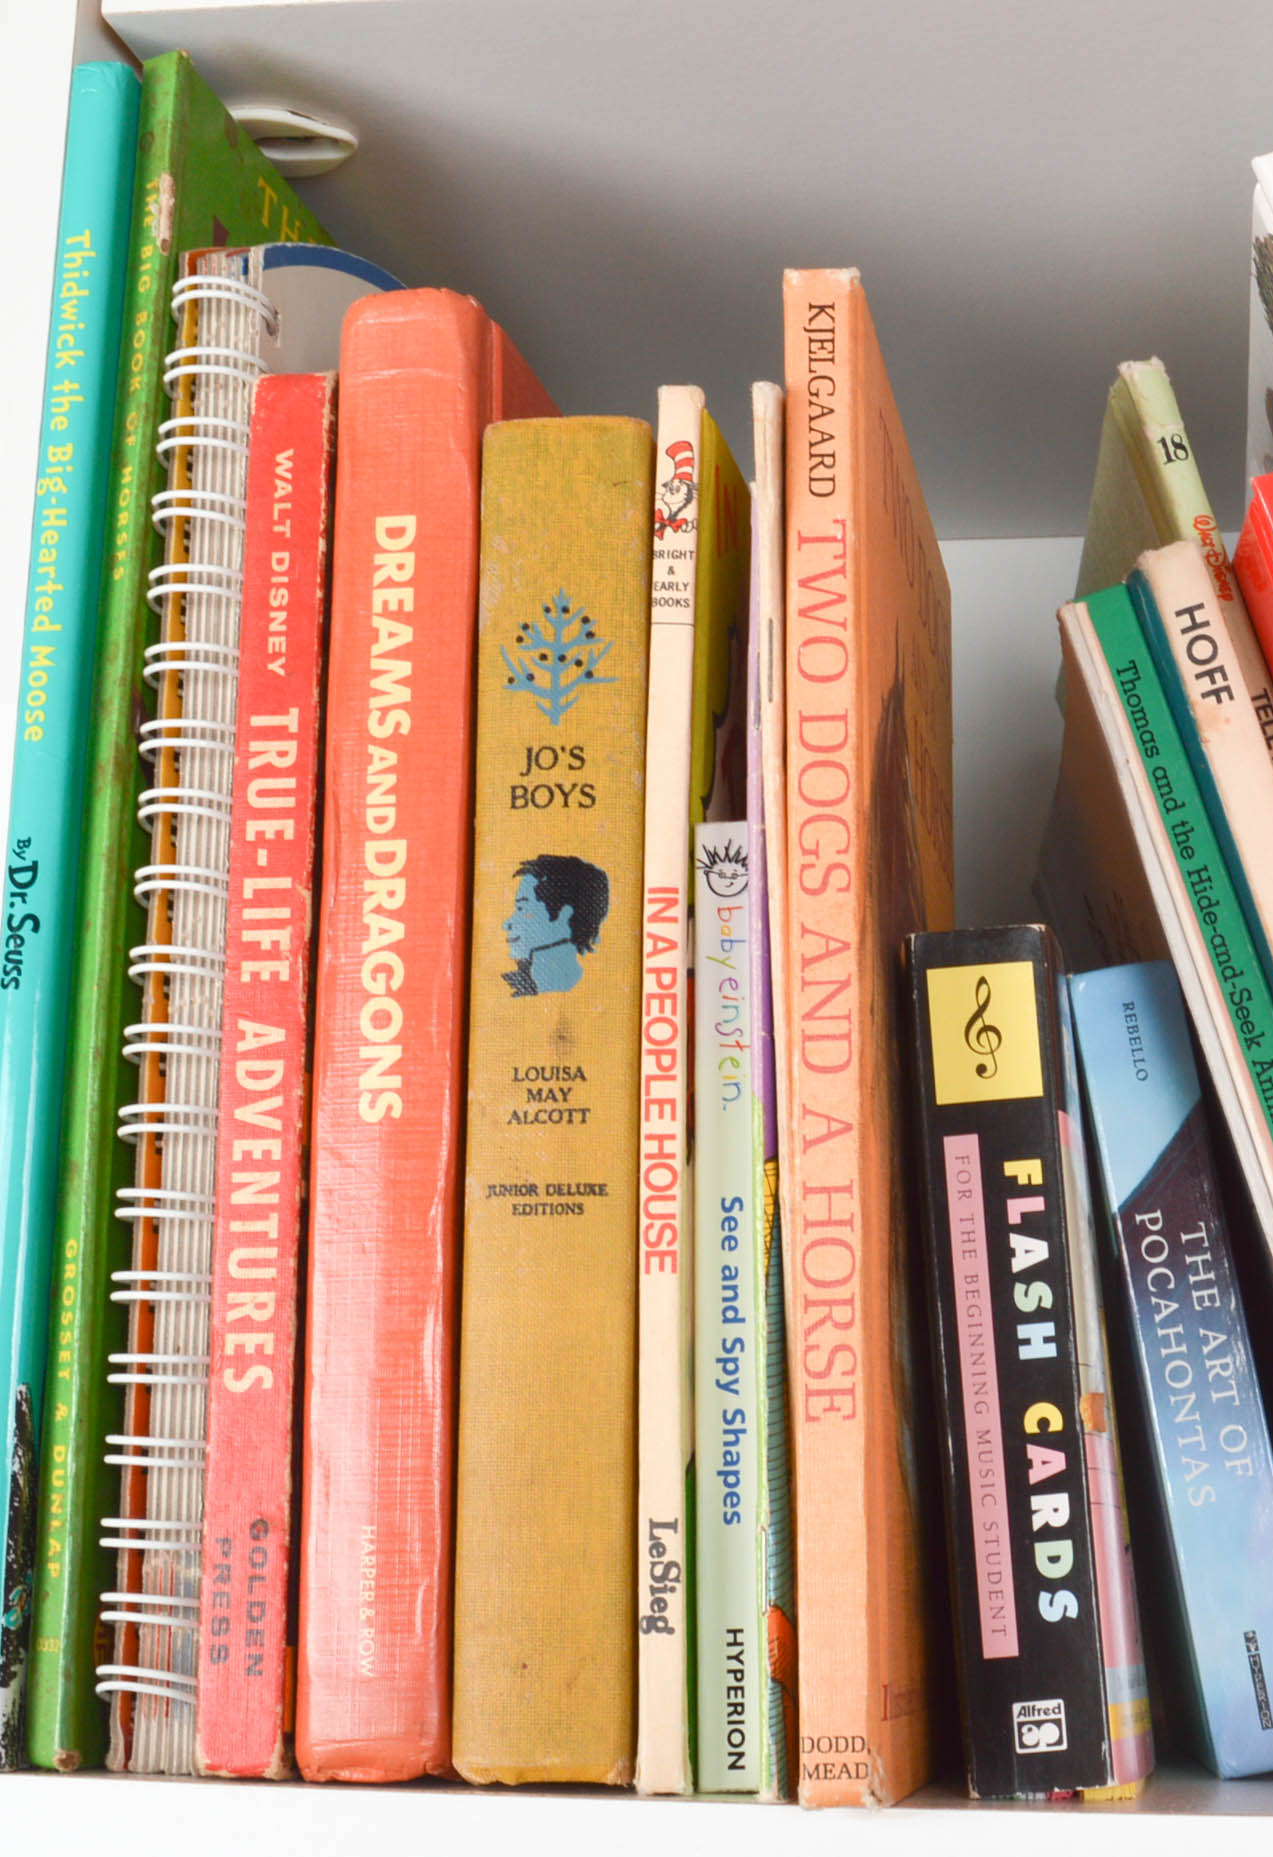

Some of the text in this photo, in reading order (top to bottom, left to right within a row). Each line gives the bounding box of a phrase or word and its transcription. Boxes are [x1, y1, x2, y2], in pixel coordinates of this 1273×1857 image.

[258, 176, 314, 244] TH
[137, 245, 154, 293] BIG
[128, 312, 150, 393] BOOK
[125, 411, 138, 446] OF
[1157, 433, 1189, 465] 18
[24, 229, 96, 742] Thidwick the Big-Hearted Moose
[113, 465, 134, 581] HORSES
[651, 597, 690, 608] BOOKS
[654, 581, 689, 592] EARLY
[667, 565, 675, 576] &
[1175, 602, 1235, 705] HOFF
[510, 783, 597, 810] BOYS
[519, 745, 586, 777] JO'S
[358, 514, 417, 1124] DREAMS AND DRAGONS
[797, 301, 858, 1424] KJELGAARD TWO DOGS AND A HORSE
[1116, 659, 1161, 760] Thomas
[1152, 765, 1187, 815] and
[1171, 819, 1195, 861] the
[1187, 864, 1266, 1051] Hide-and-Seek
[1, 836, 41, 990] By Dr. Seuss
[223, 448, 299, 1393] WALT DISNEY TRUE-LIFE ADVENTURES
[705, 905, 746, 970] baby
[513, 1065, 587, 1084] LOUISA
[643, 887, 680, 1275] IN A PEOPLE HOUSE
[1122, 1000, 1149, 1083] REBELLO
[507, 1108, 592, 1126] ALCOTT
[526, 1086, 573, 1104] MAY
[485, 1182, 609, 1199] JUNIOR DELUXE
[511, 1202, 585, 1217] EDITIONS
[715, 1196, 748, 1526] See and Spy Shapes
[954, 1154, 1008, 1638] FOR THE BEGINNING MUSIC STUDENT
[1003, 1157, 1079, 1623] FLASH CARDS
[1135, 1208, 1217, 1508] POCAHONTAS
[1180, 1221, 1254, 1477] THE ART OF
[48, 1238, 78, 1579] GROSSET & DUNLAP
[209, 1536, 233, 1665] PRESS
[244, 1516, 270, 1678] GOLDEN
[358, 1524, 378, 1678] HARPER & ROW
[639, 1517, 682, 1636] LeSieg
[726, 1627, 747, 1771] HYPERION
[1016, 1701, 1063, 1719] Alfred
[802, 1762, 869, 1781] MEAD
